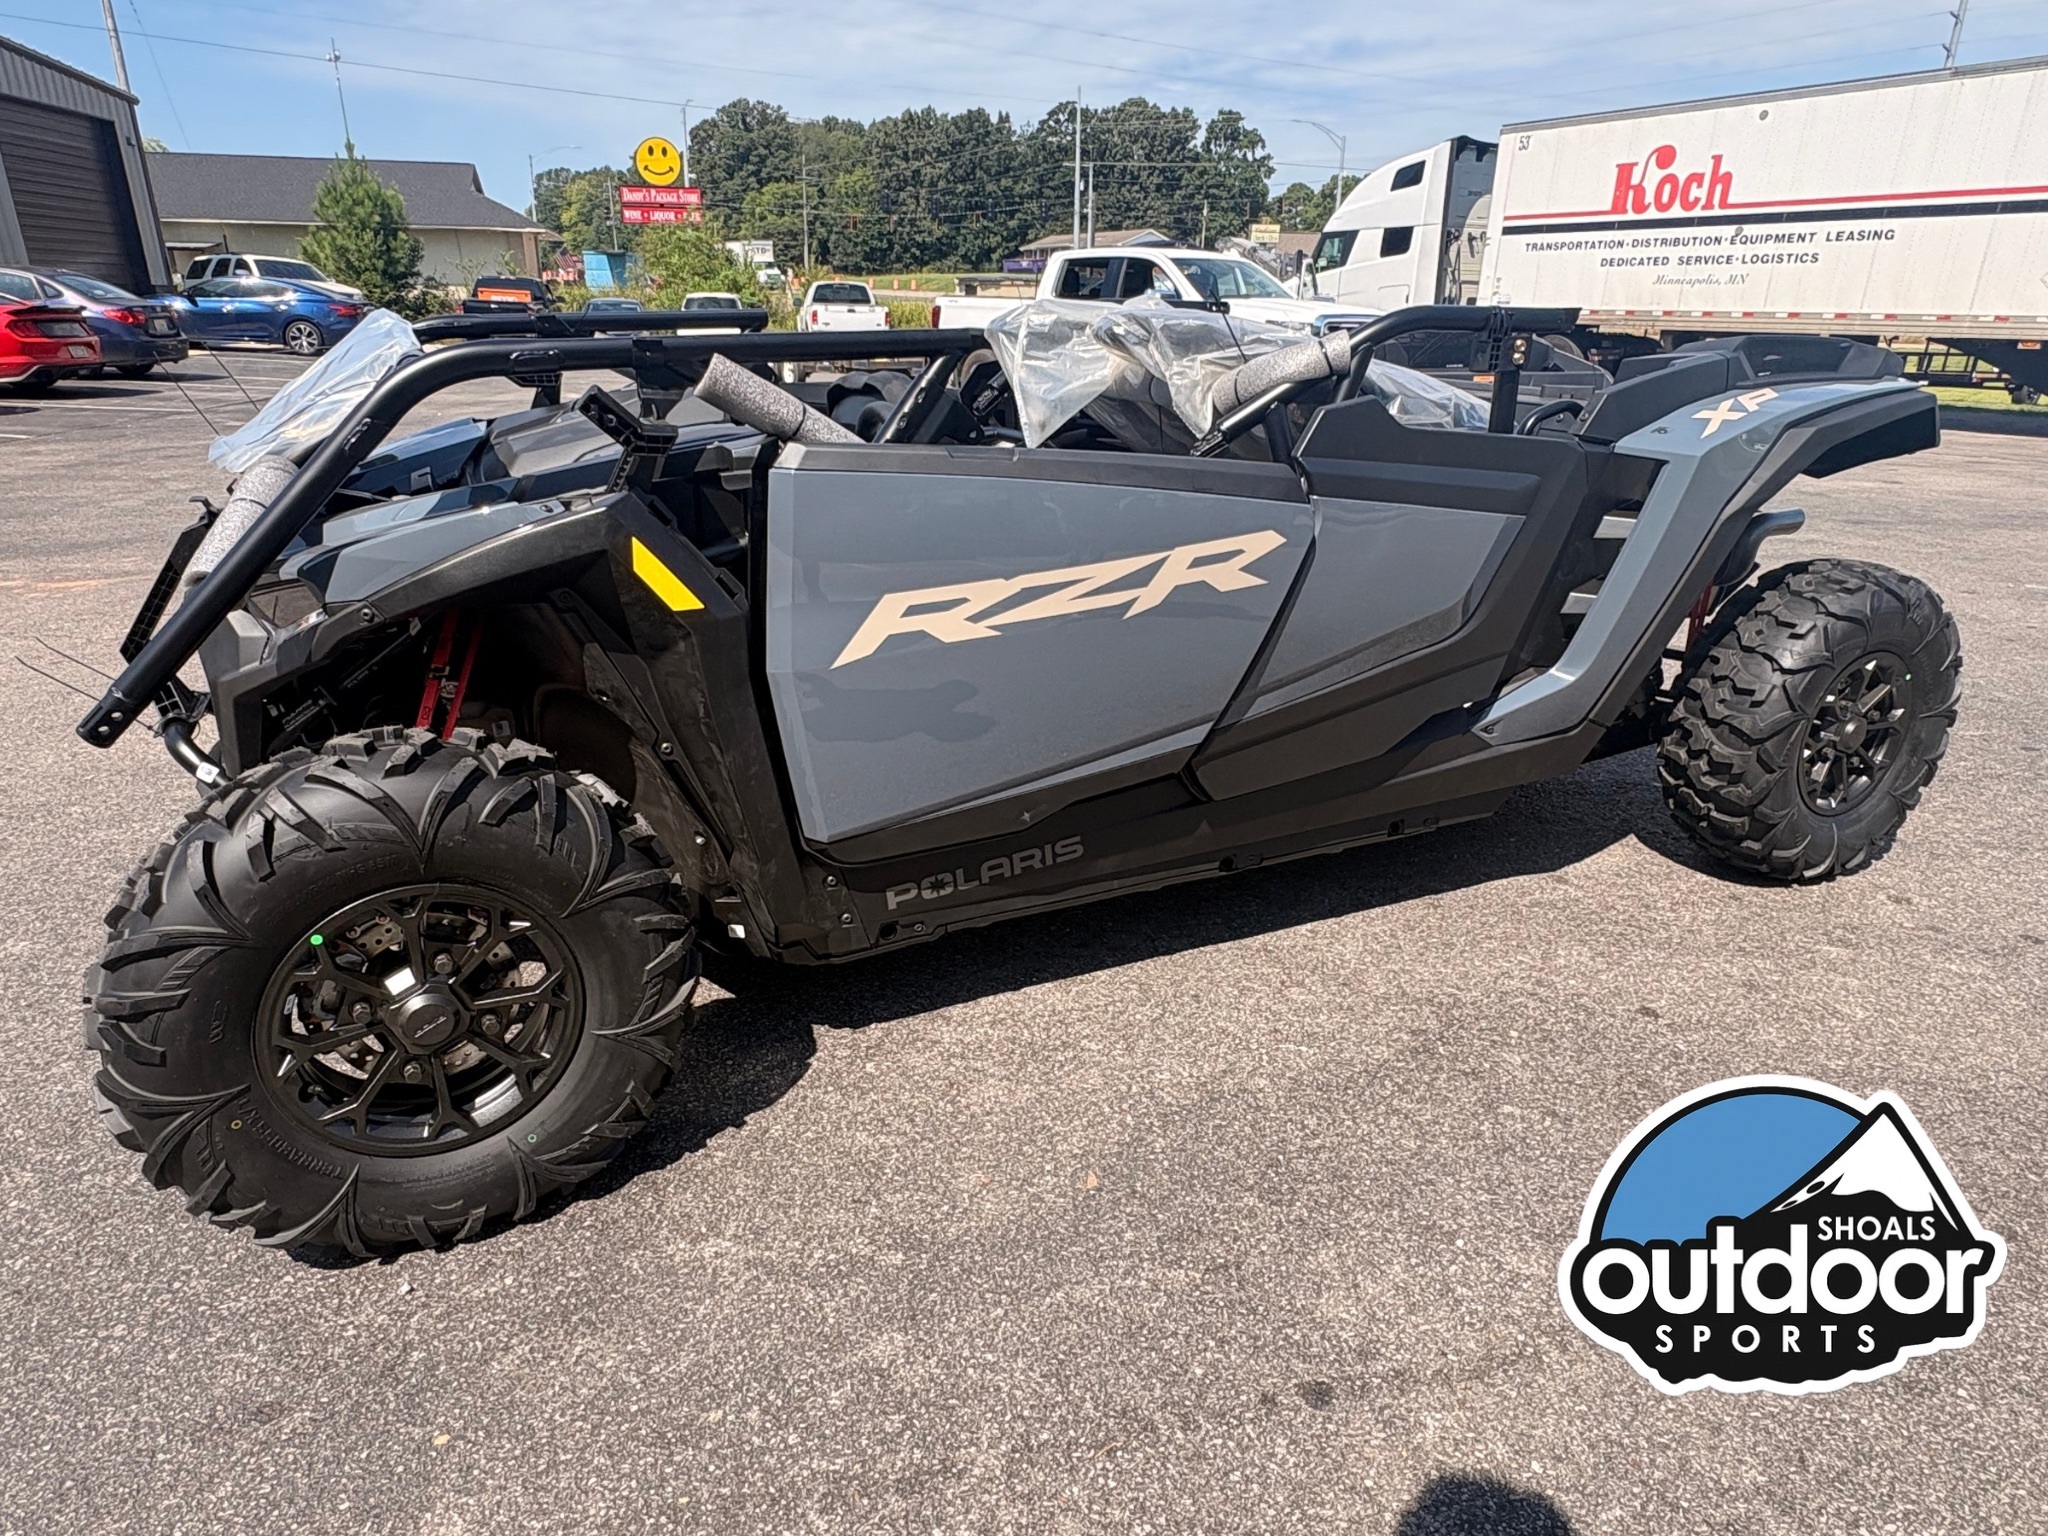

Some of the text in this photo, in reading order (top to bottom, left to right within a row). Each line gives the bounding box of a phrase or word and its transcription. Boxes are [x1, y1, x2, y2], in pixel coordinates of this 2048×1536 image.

[1611, 144, 1733, 214] Koch
[623, 209, 643, 220] WINE
[649, 210, 676, 221] LIQUOR
[1525, 229, 1896, 252] TRANSPORTATION DISTRIBUTION EQUIPMENT LEASING
[1600, 253, 1820, 267] DEDICATED SERVICE LOGISTICS
[1724, 273, 1750, 285] MN
[1690, 387, 1780, 440] XP
[828, 529, 1288, 670] RZR
[885, 835, 1085, 911] POLARIS
